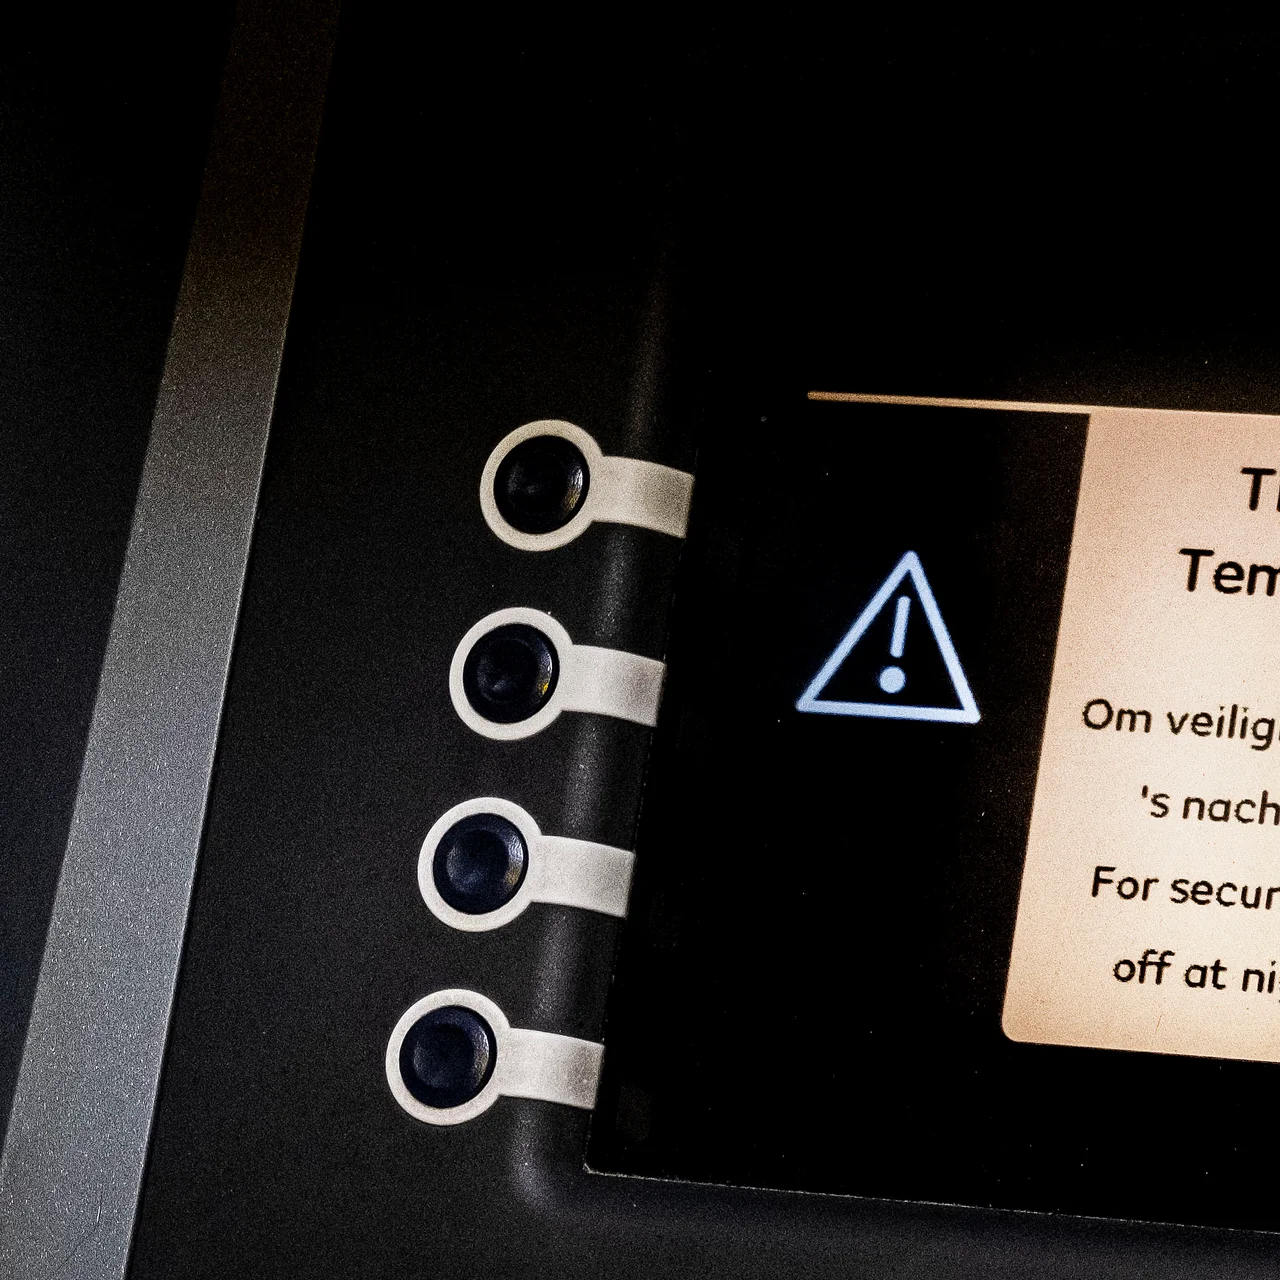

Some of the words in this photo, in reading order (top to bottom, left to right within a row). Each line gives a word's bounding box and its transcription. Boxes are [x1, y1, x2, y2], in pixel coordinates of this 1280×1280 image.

[1082, 699, 1151, 733] Om
[1142, 785, 1170, 818] 's
[1092, 866, 1159, 901] For
[1113, 949, 1175, 985] off
[1184, 959, 1227, 990] at
